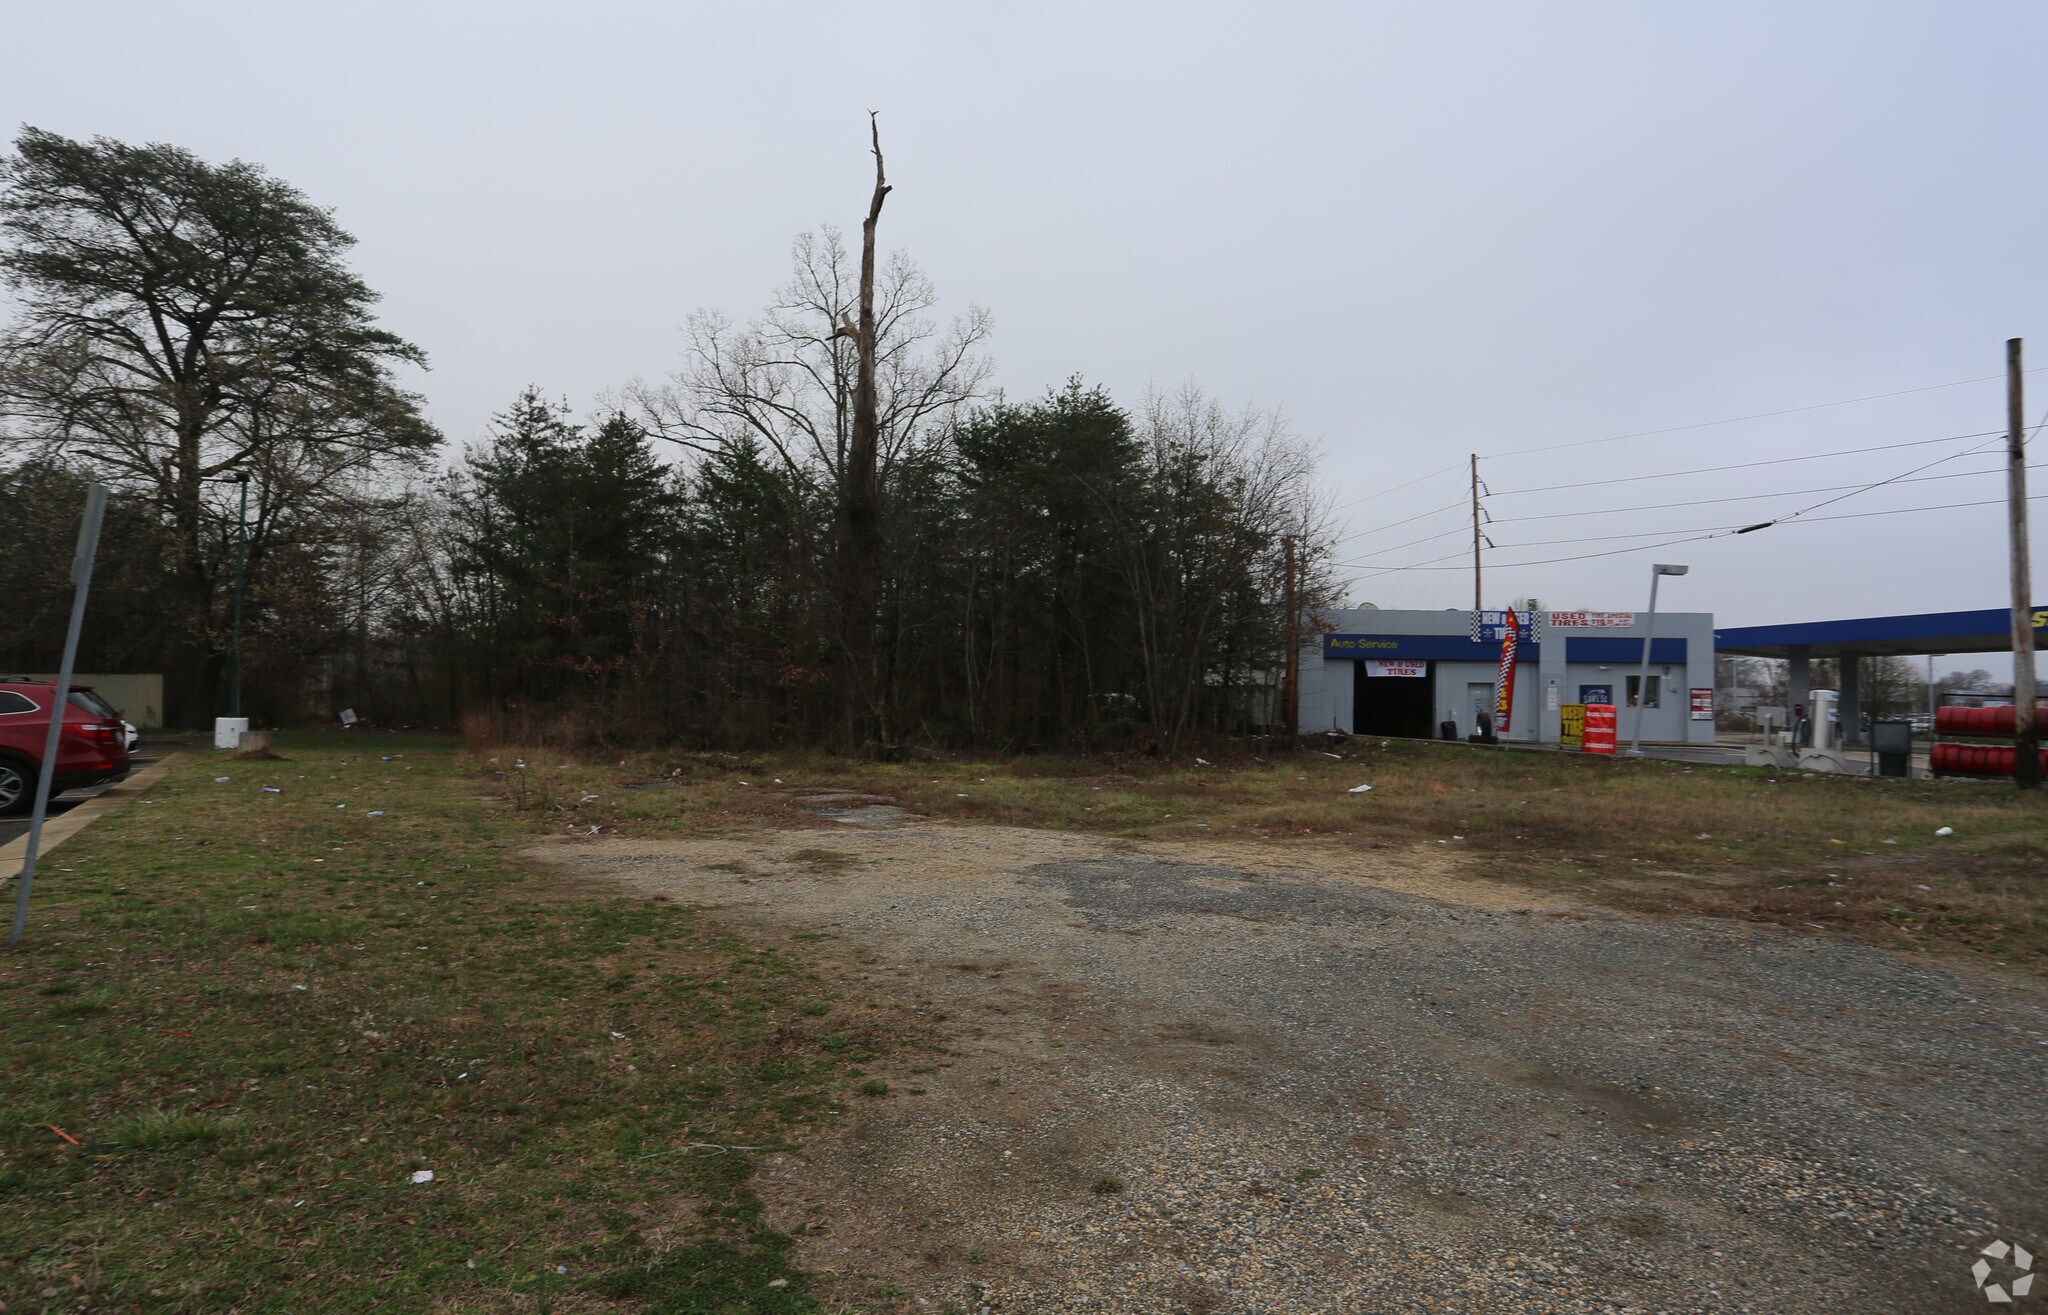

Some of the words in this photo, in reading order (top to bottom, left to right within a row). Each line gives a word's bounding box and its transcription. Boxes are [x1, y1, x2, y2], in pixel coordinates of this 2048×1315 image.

[1481, 612, 1501, 625] NEW
[2031, 610, 2048, 628] S
[1330, 638, 1355, 648] Auto
[1358, 639, 1398, 649] Service
[1387, 668, 1417, 676] TIRES
